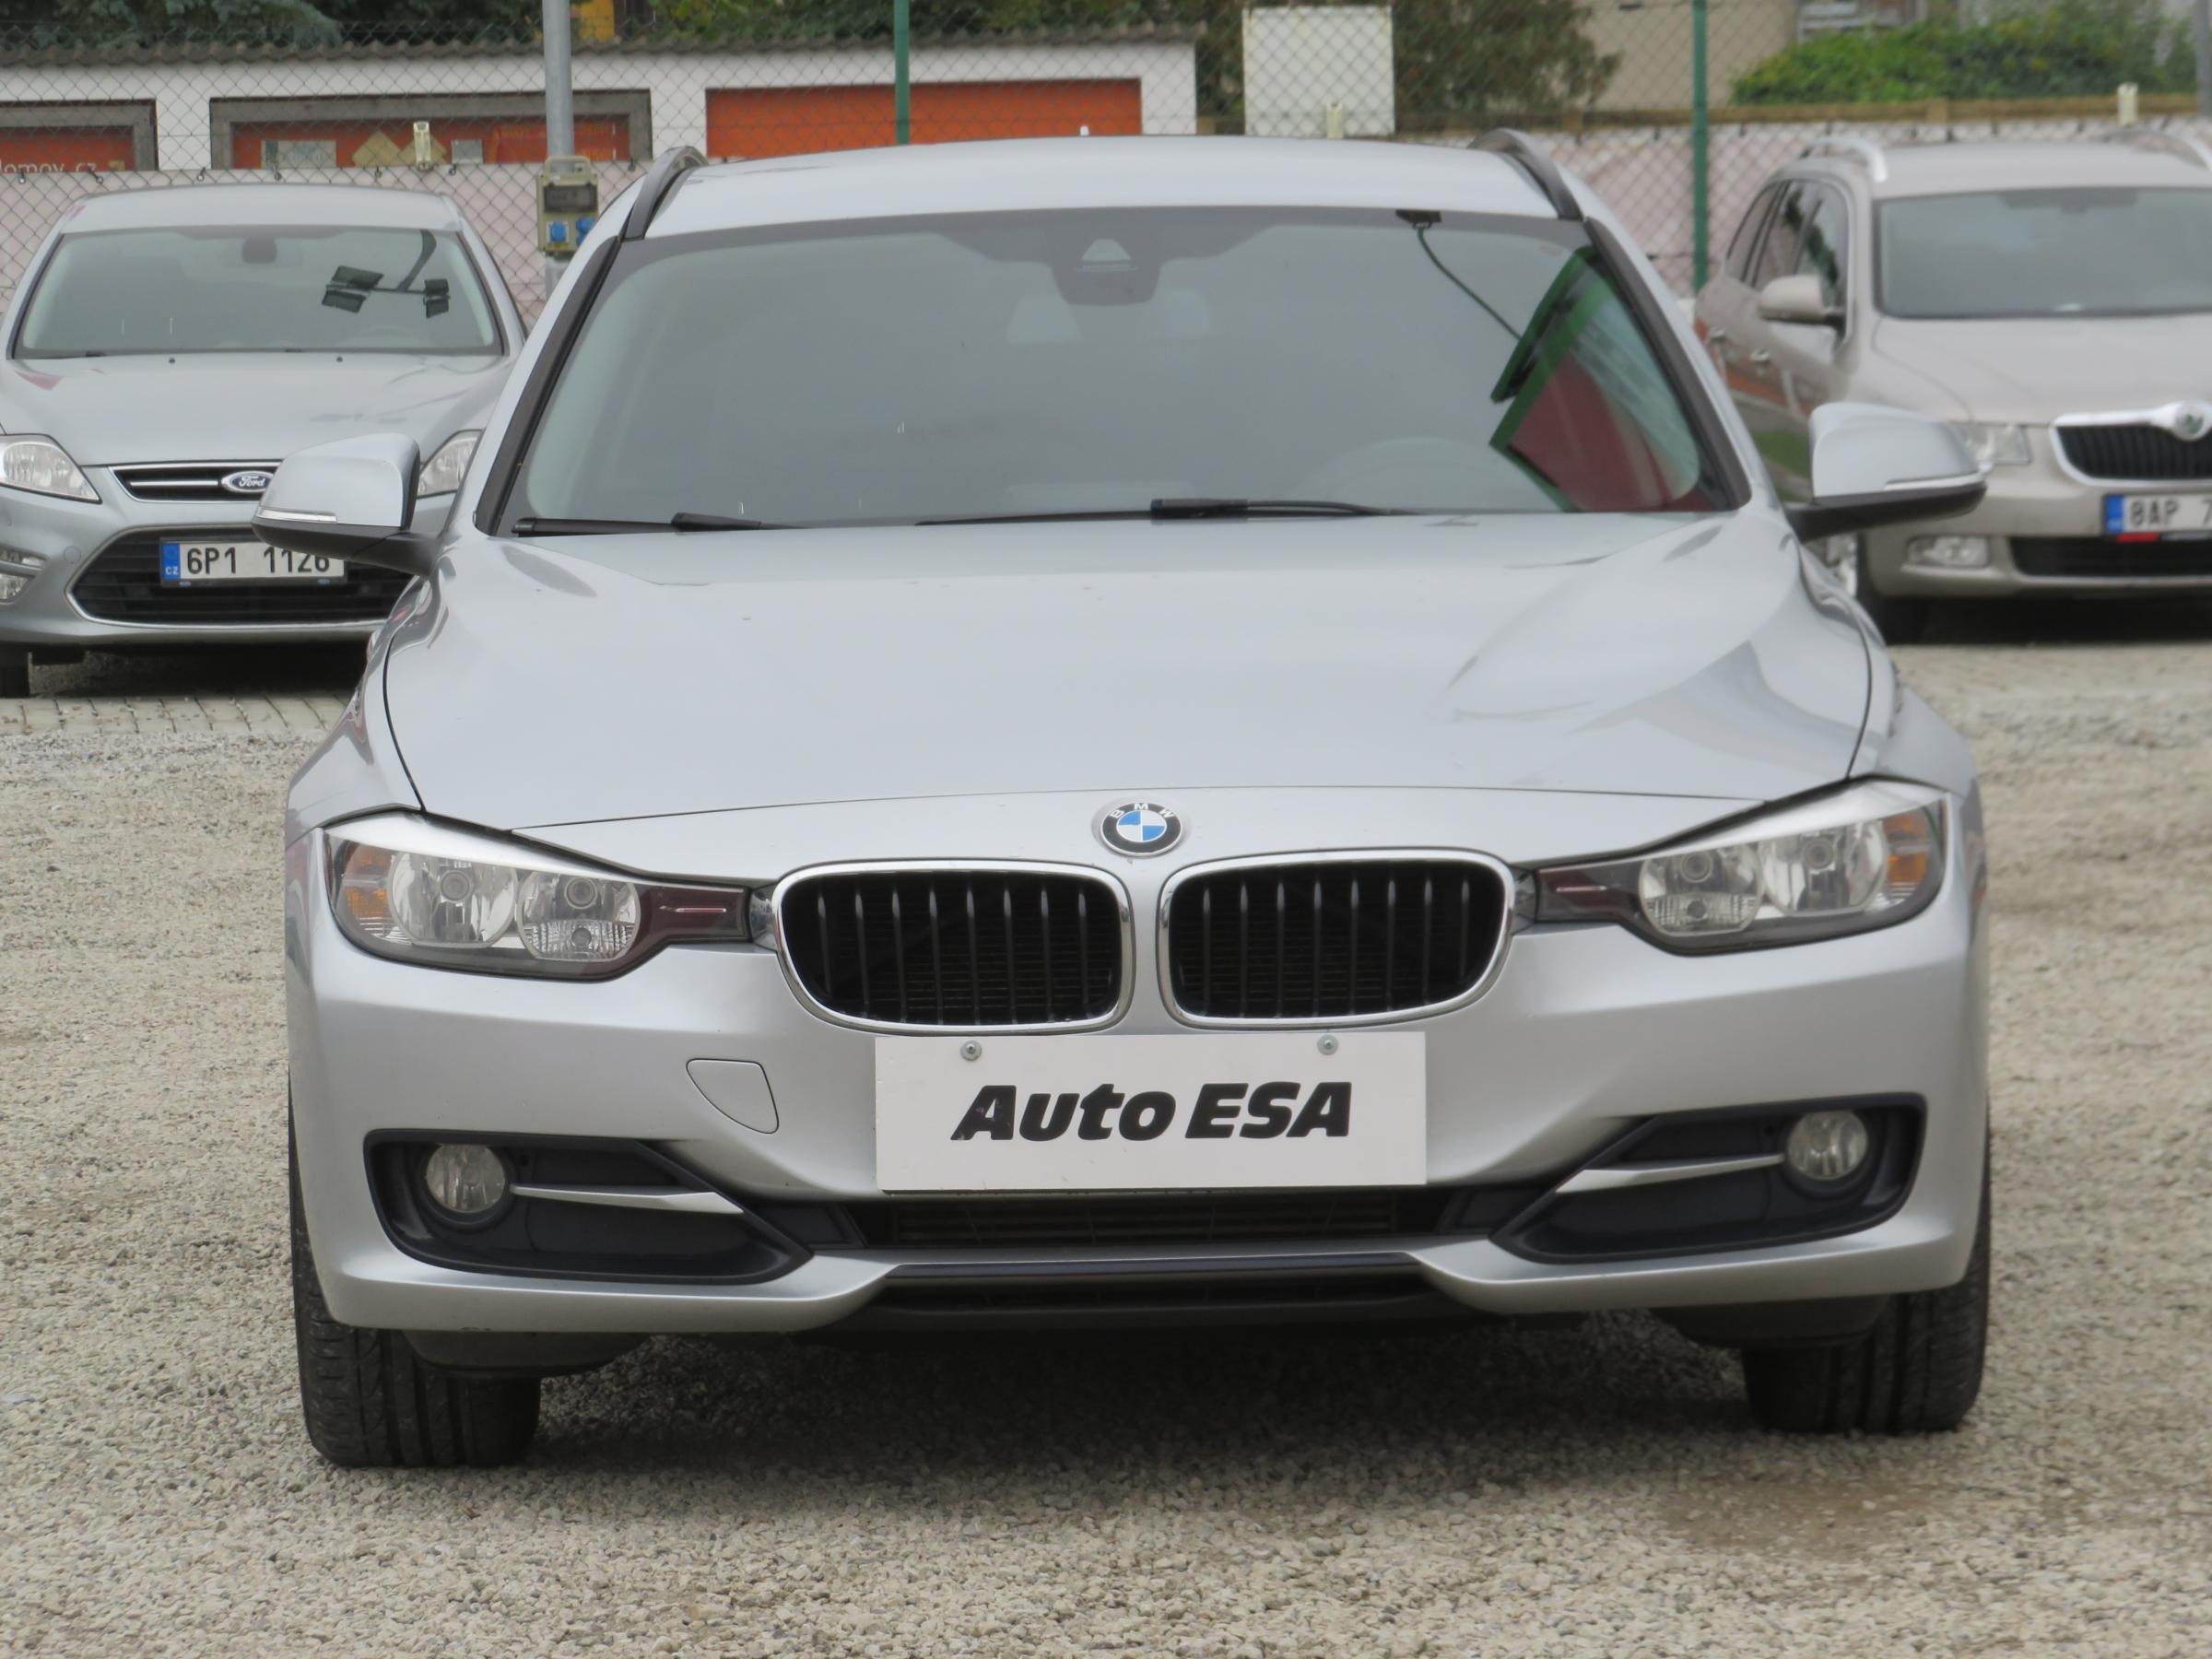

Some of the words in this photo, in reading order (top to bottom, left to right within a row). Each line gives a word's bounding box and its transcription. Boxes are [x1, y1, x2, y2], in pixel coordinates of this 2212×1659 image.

[238, 475, 266, 488] Ford
[187, 547, 236, 575] 6P1
[165, 566, 179, 576] CZ
[1110, 803, 1175, 818] BMW
[950, 1083, 1176, 1142] Auto
[1184, 1081, 1352, 1139] ESA
